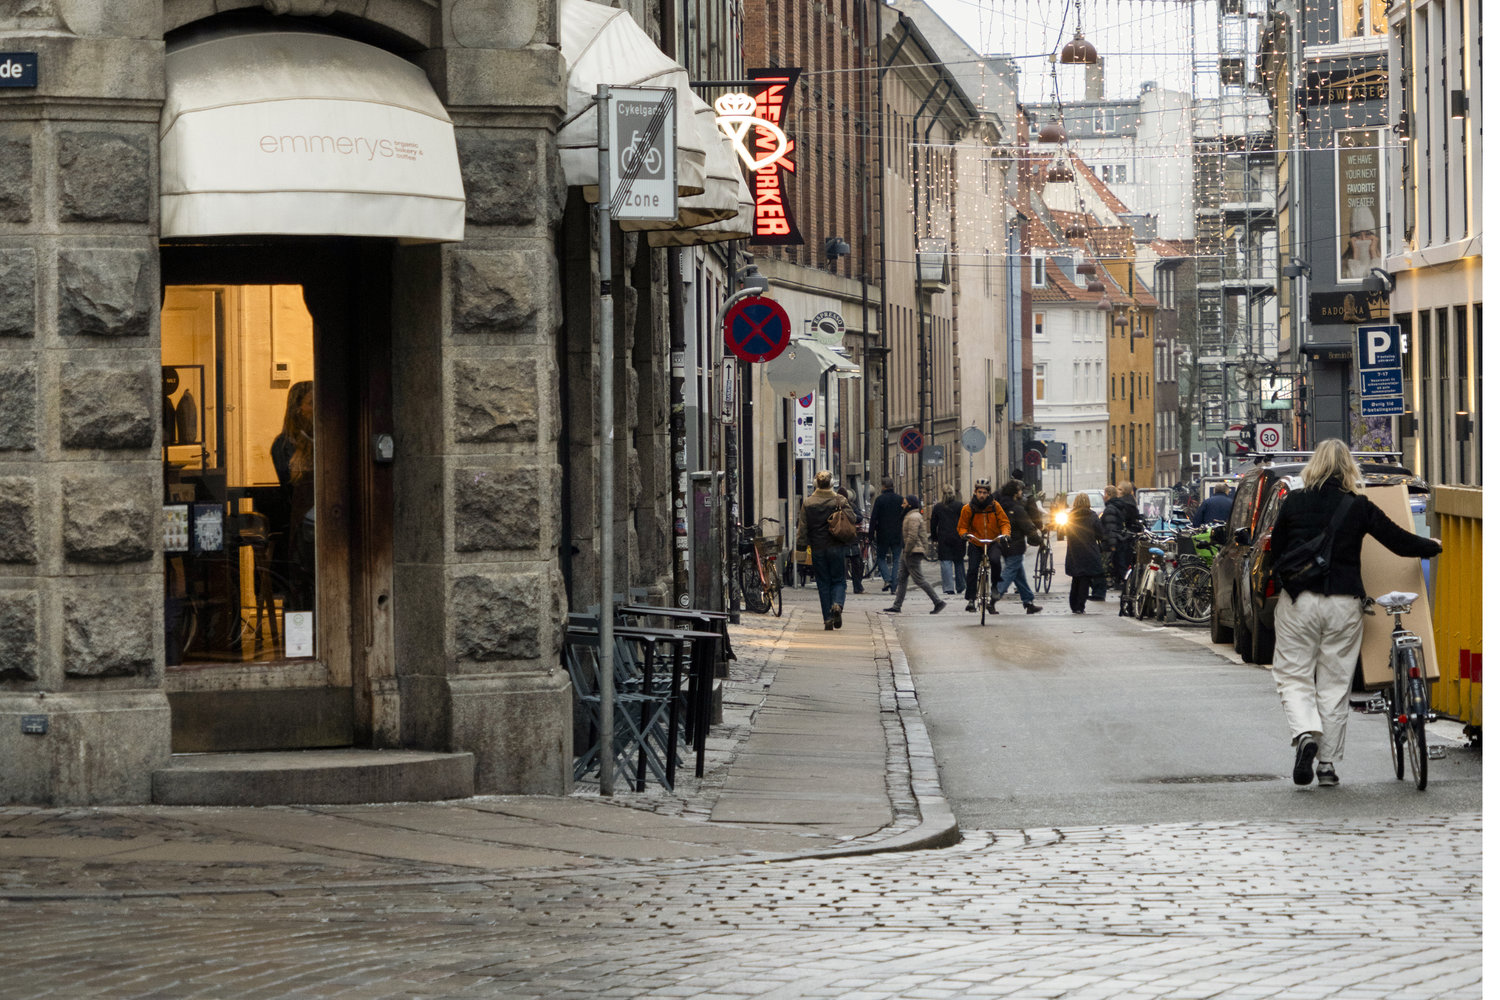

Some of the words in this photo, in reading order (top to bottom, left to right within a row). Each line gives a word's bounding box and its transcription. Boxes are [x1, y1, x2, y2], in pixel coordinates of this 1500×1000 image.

[259, 135, 394, 161] emmerys
[1347, 155, 1357, 164] WE
[1358, 154, 1373, 164] HAVE
[1345, 169, 1361, 179] YOUR
[1361, 168, 1377, 178] NEXT
[1347, 183, 1375, 193] FAVORITE
[625, 191, 660, 206] Zone
[1347, 197, 1375, 208] SWEATER
[812, 311, 843, 325] ESPRESSO
[1367, 331, 1391, 365] P
